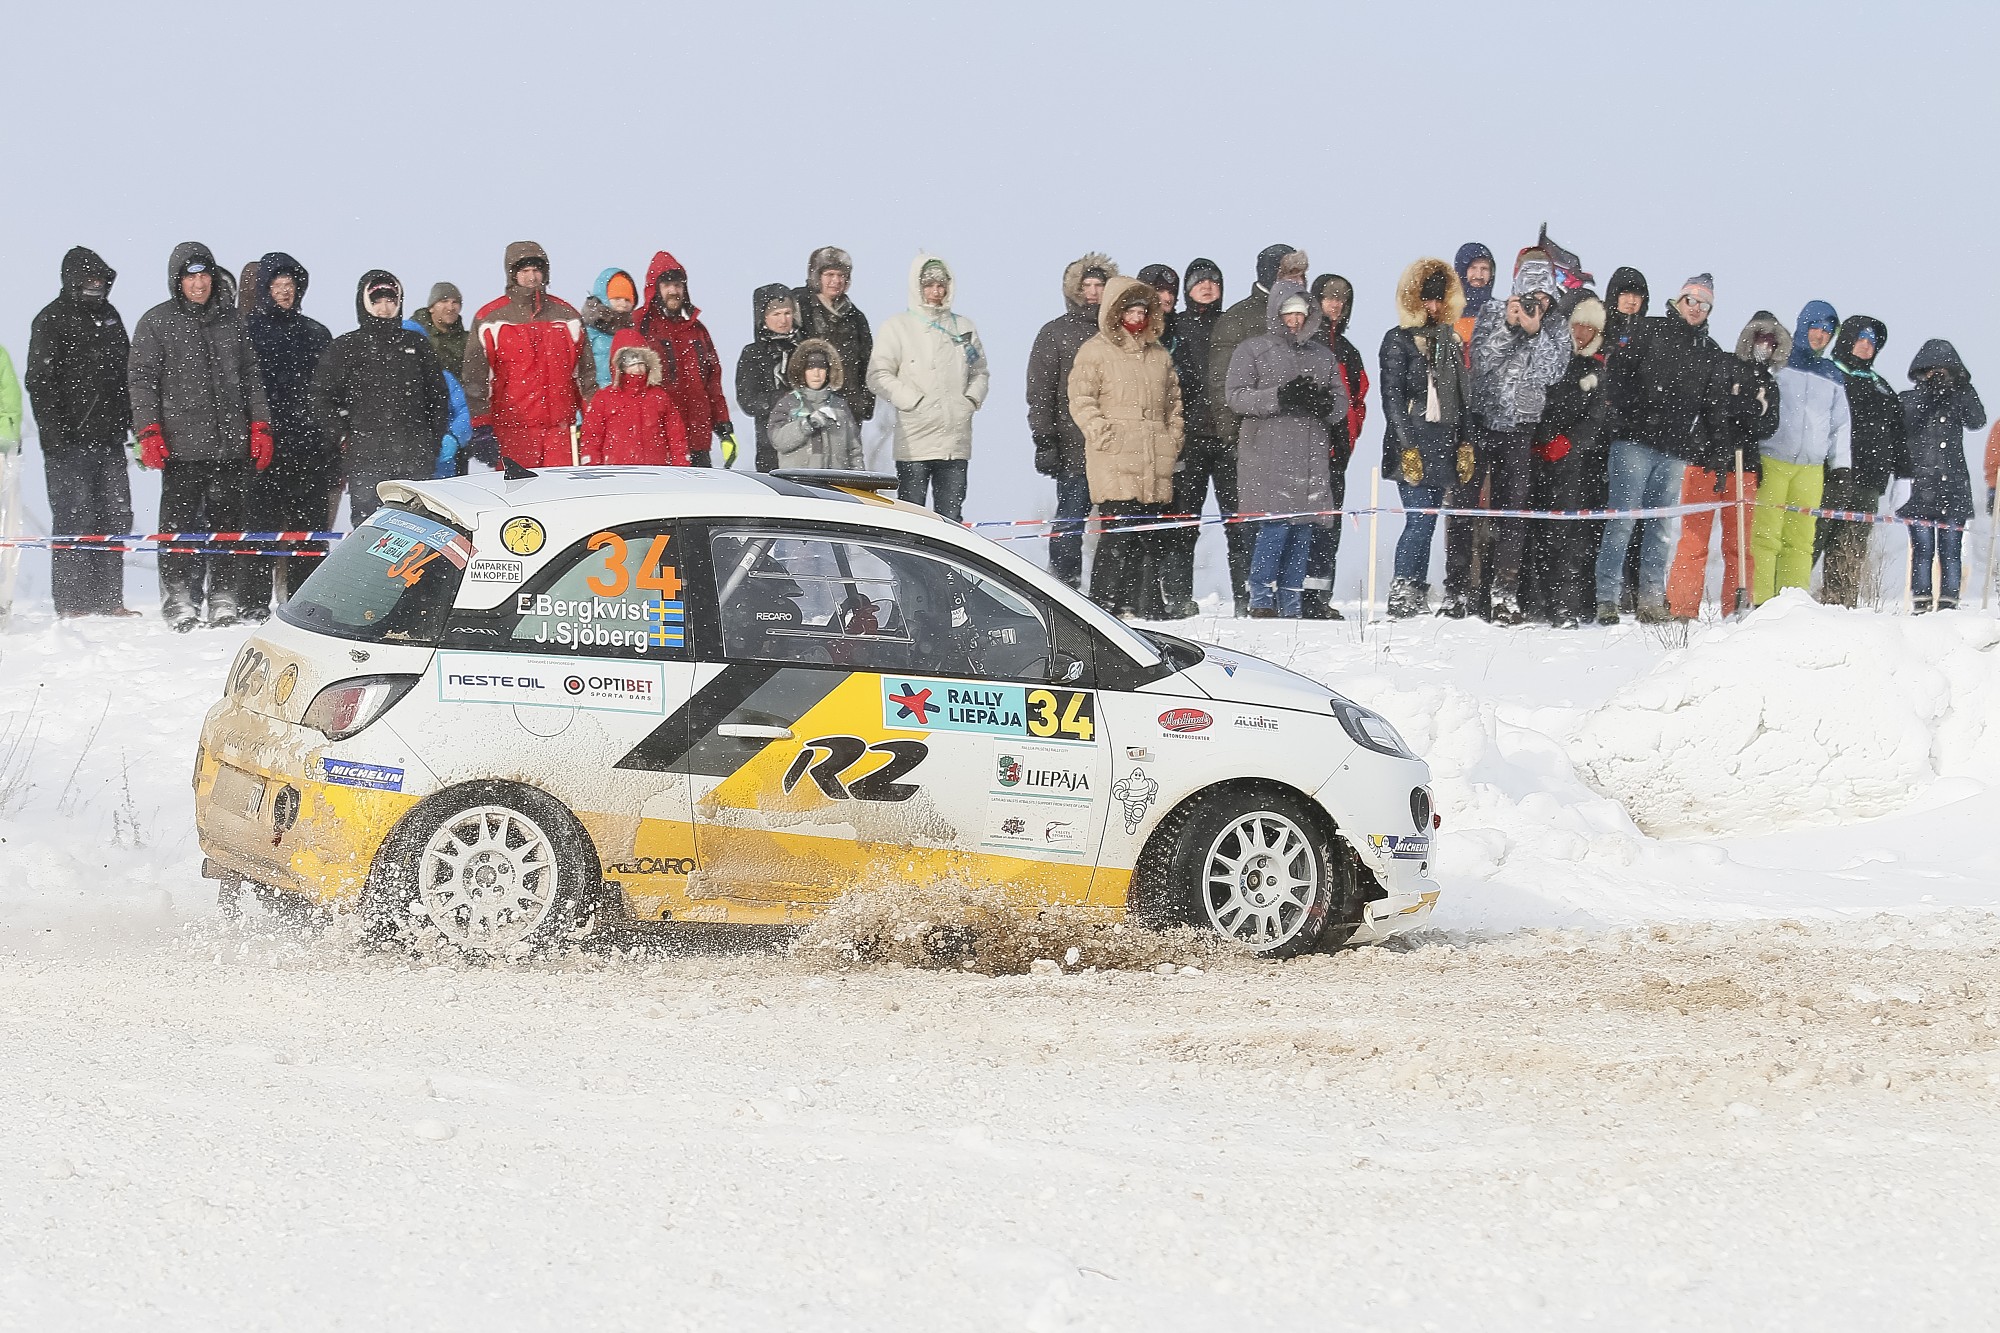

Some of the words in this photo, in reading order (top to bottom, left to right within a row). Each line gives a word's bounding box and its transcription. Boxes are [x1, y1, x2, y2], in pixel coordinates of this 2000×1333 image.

[387, 543, 441, 588] 34
[470, 562, 520, 572] UMPARKEN
[586, 531, 682, 599] 34
[483, 572, 520, 581] KOPF.DE
[516, 592, 650, 623] E.Bergkvist
[756, 612, 793, 621] RECARO
[534, 621, 649, 653] J.Sjöberg
[448, 674, 514, 688] NESTE
[517, 676, 546, 690] OIL
[588, 676, 653, 694] OPTIBET
[590, 691, 624, 699] SPORTA
[947, 688, 1004, 707] RALLY
[949, 707, 1023, 728] LIEPĀJA
[1027, 689, 1094, 740] 34
[330, 765, 403, 783] MICHELIN
[782, 734, 930, 802] R2
[1026, 769, 1090, 792] LIEPĀJA
